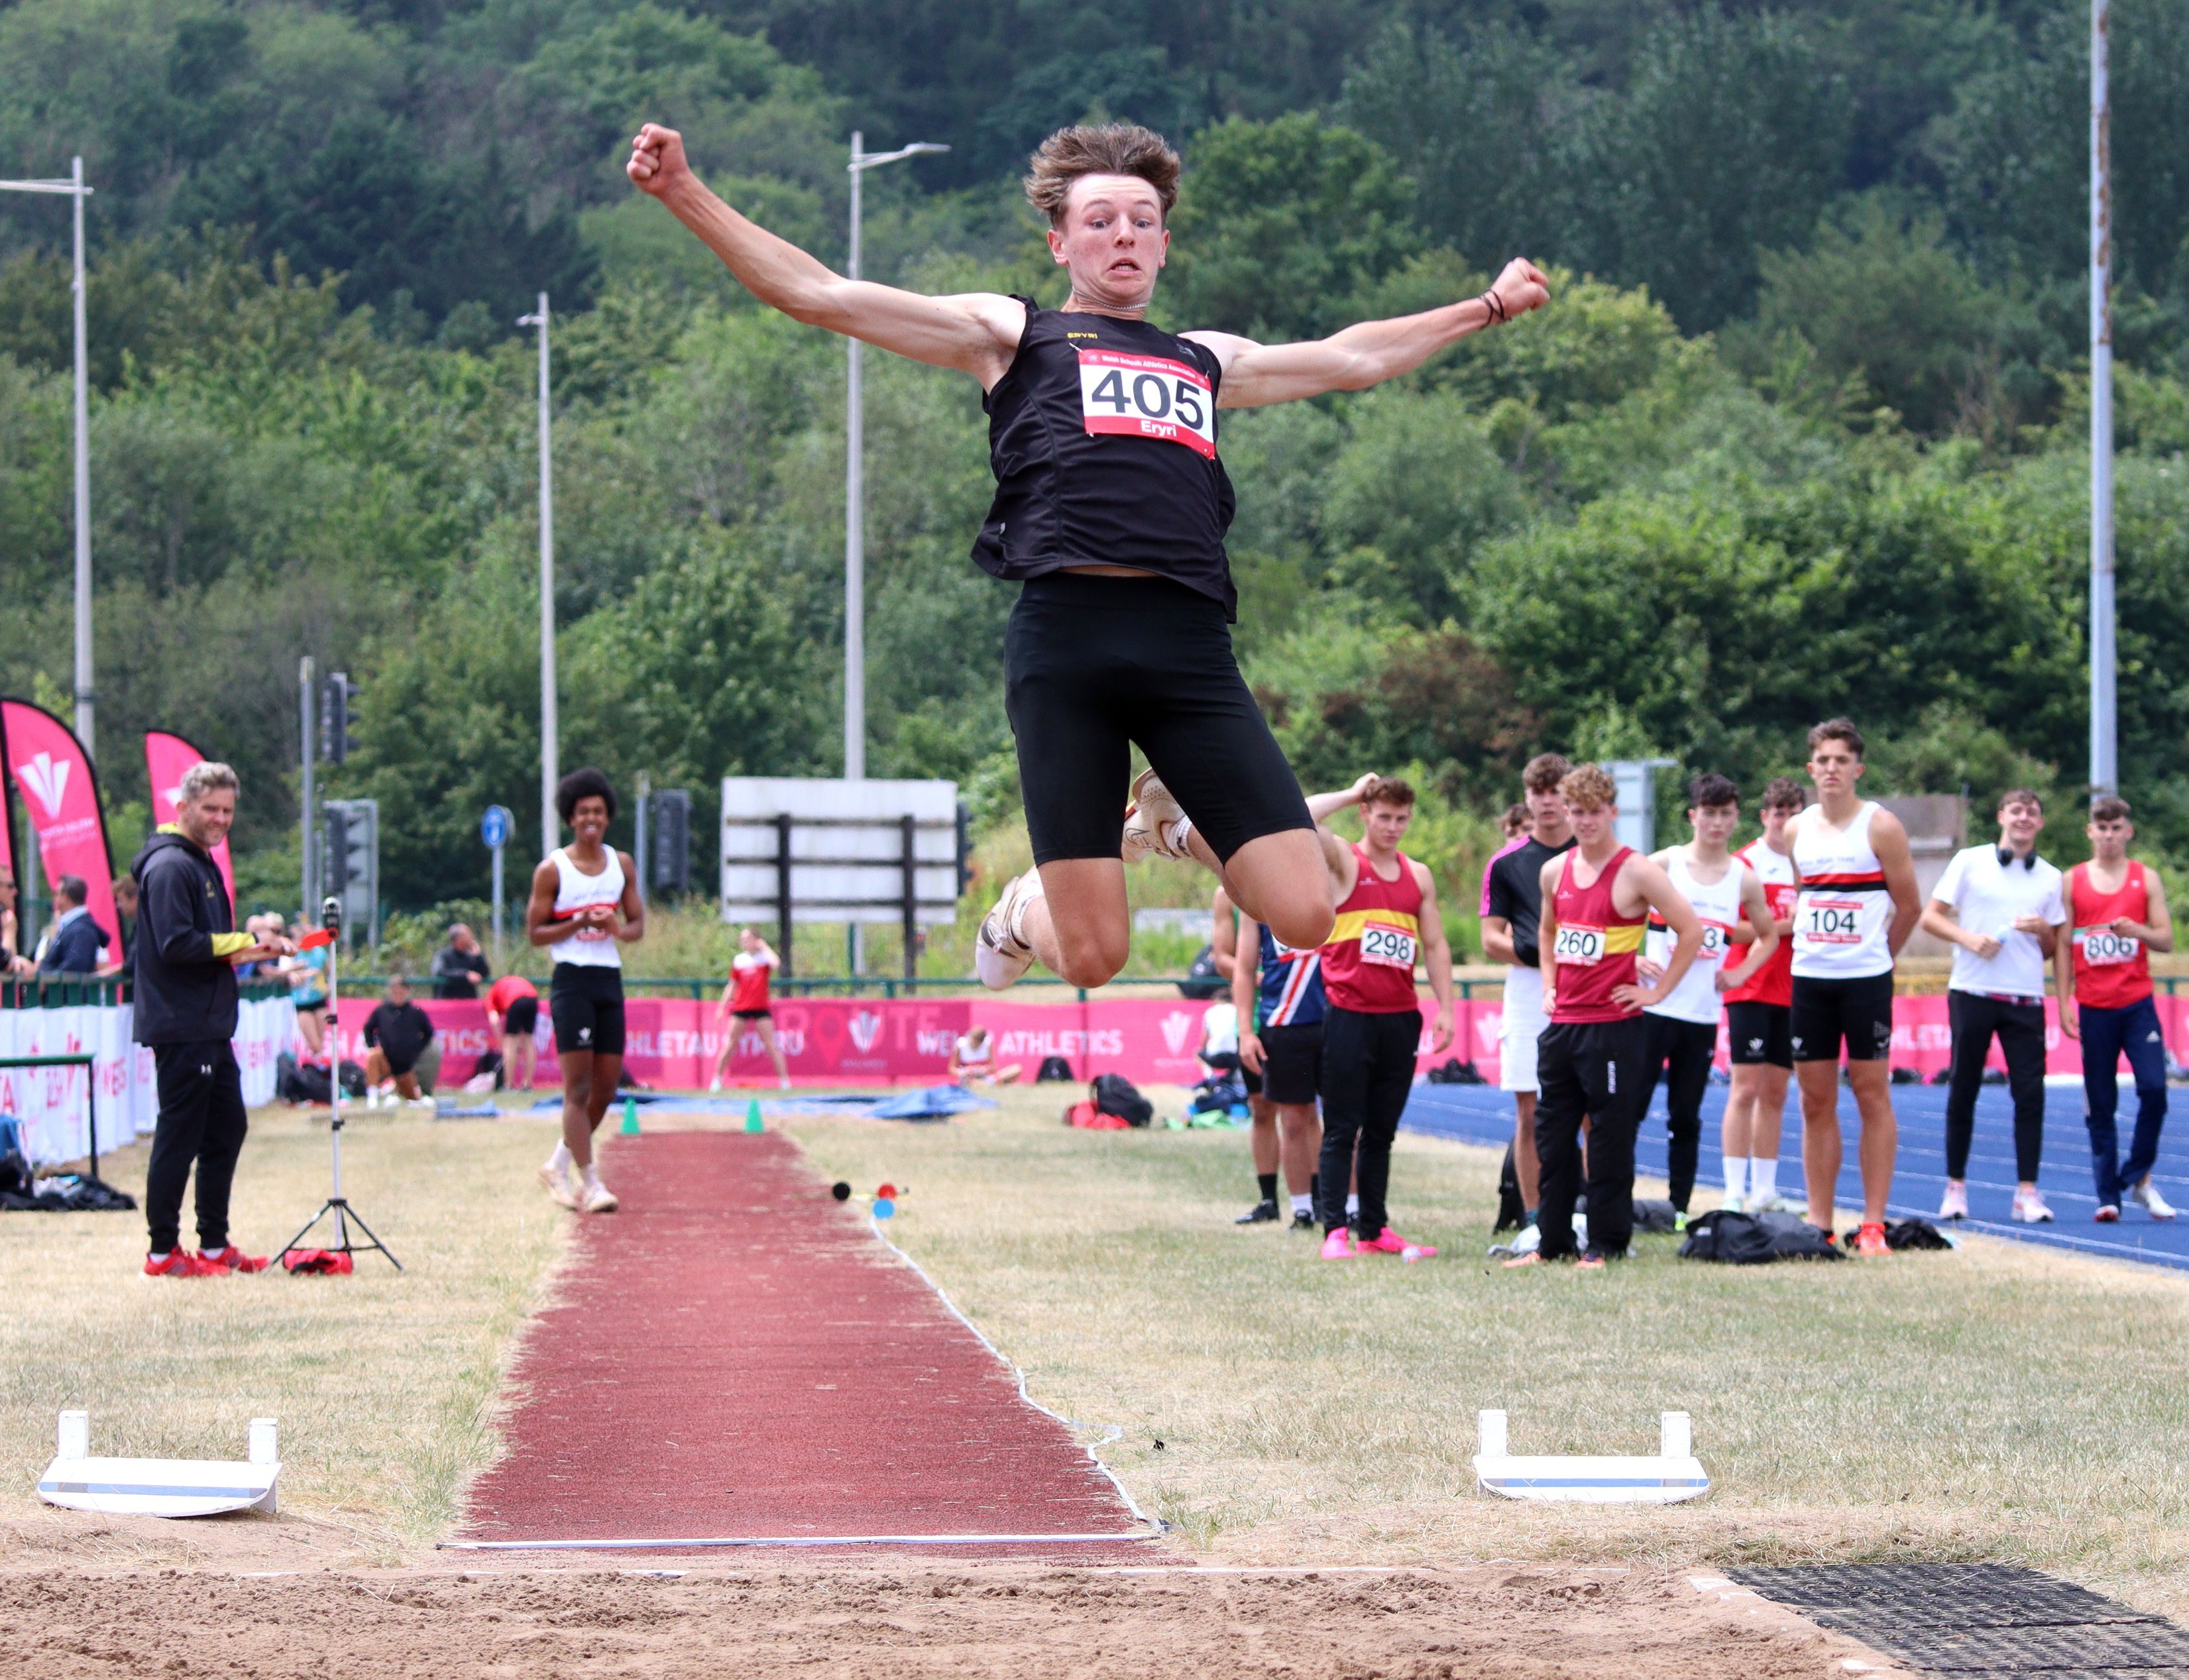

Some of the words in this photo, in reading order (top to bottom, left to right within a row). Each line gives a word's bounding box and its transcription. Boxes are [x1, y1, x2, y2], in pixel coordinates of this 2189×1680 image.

[1119, 357, 1142, 366] Schools
[1143, 361, 1168, 369] Athletics
[1092, 370, 1204, 430] 405
[1141, 420, 1177, 437] Eryri
[1811, 909, 1856, 933] 104
[1366, 930, 1410, 960] 298
[1558, 930, 1597, 956] 260
[2088, 934, 2132, 957] 806
[626, 1030, 718, 1058] HLETAU
[998, 1029, 1124, 1056] ATHLETICS
